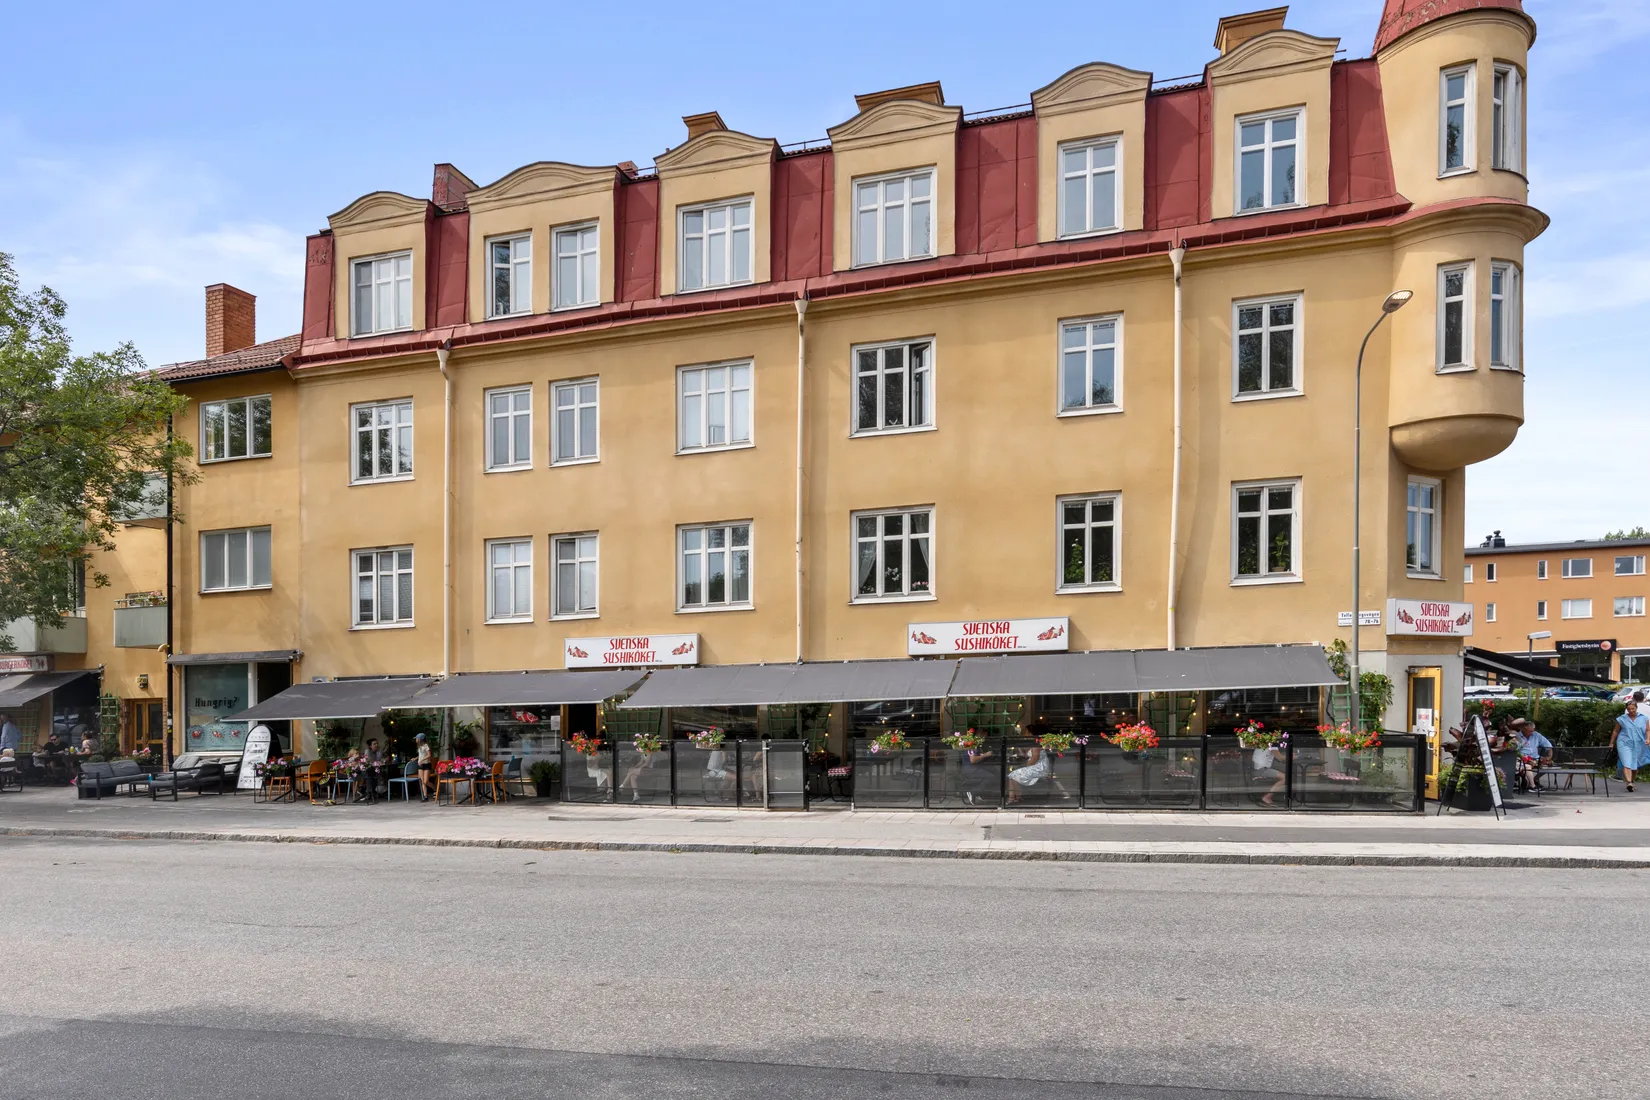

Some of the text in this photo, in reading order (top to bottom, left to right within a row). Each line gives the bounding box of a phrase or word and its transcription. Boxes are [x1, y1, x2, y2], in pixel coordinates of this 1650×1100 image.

[1420, 602, 1450, 617] SVENSKA
[962, 621, 1010, 636] SVENSKA
[1415, 618, 1454, 633] SUSHIKÖKET
[609, 637, 649, 650] SVENSKA
[954, 635, 1019, 651] SUSHIKÖKET
[602, 650, 656, 664] SUSHIKÖKET
[195, 696, 238, 709] Hungrig?
